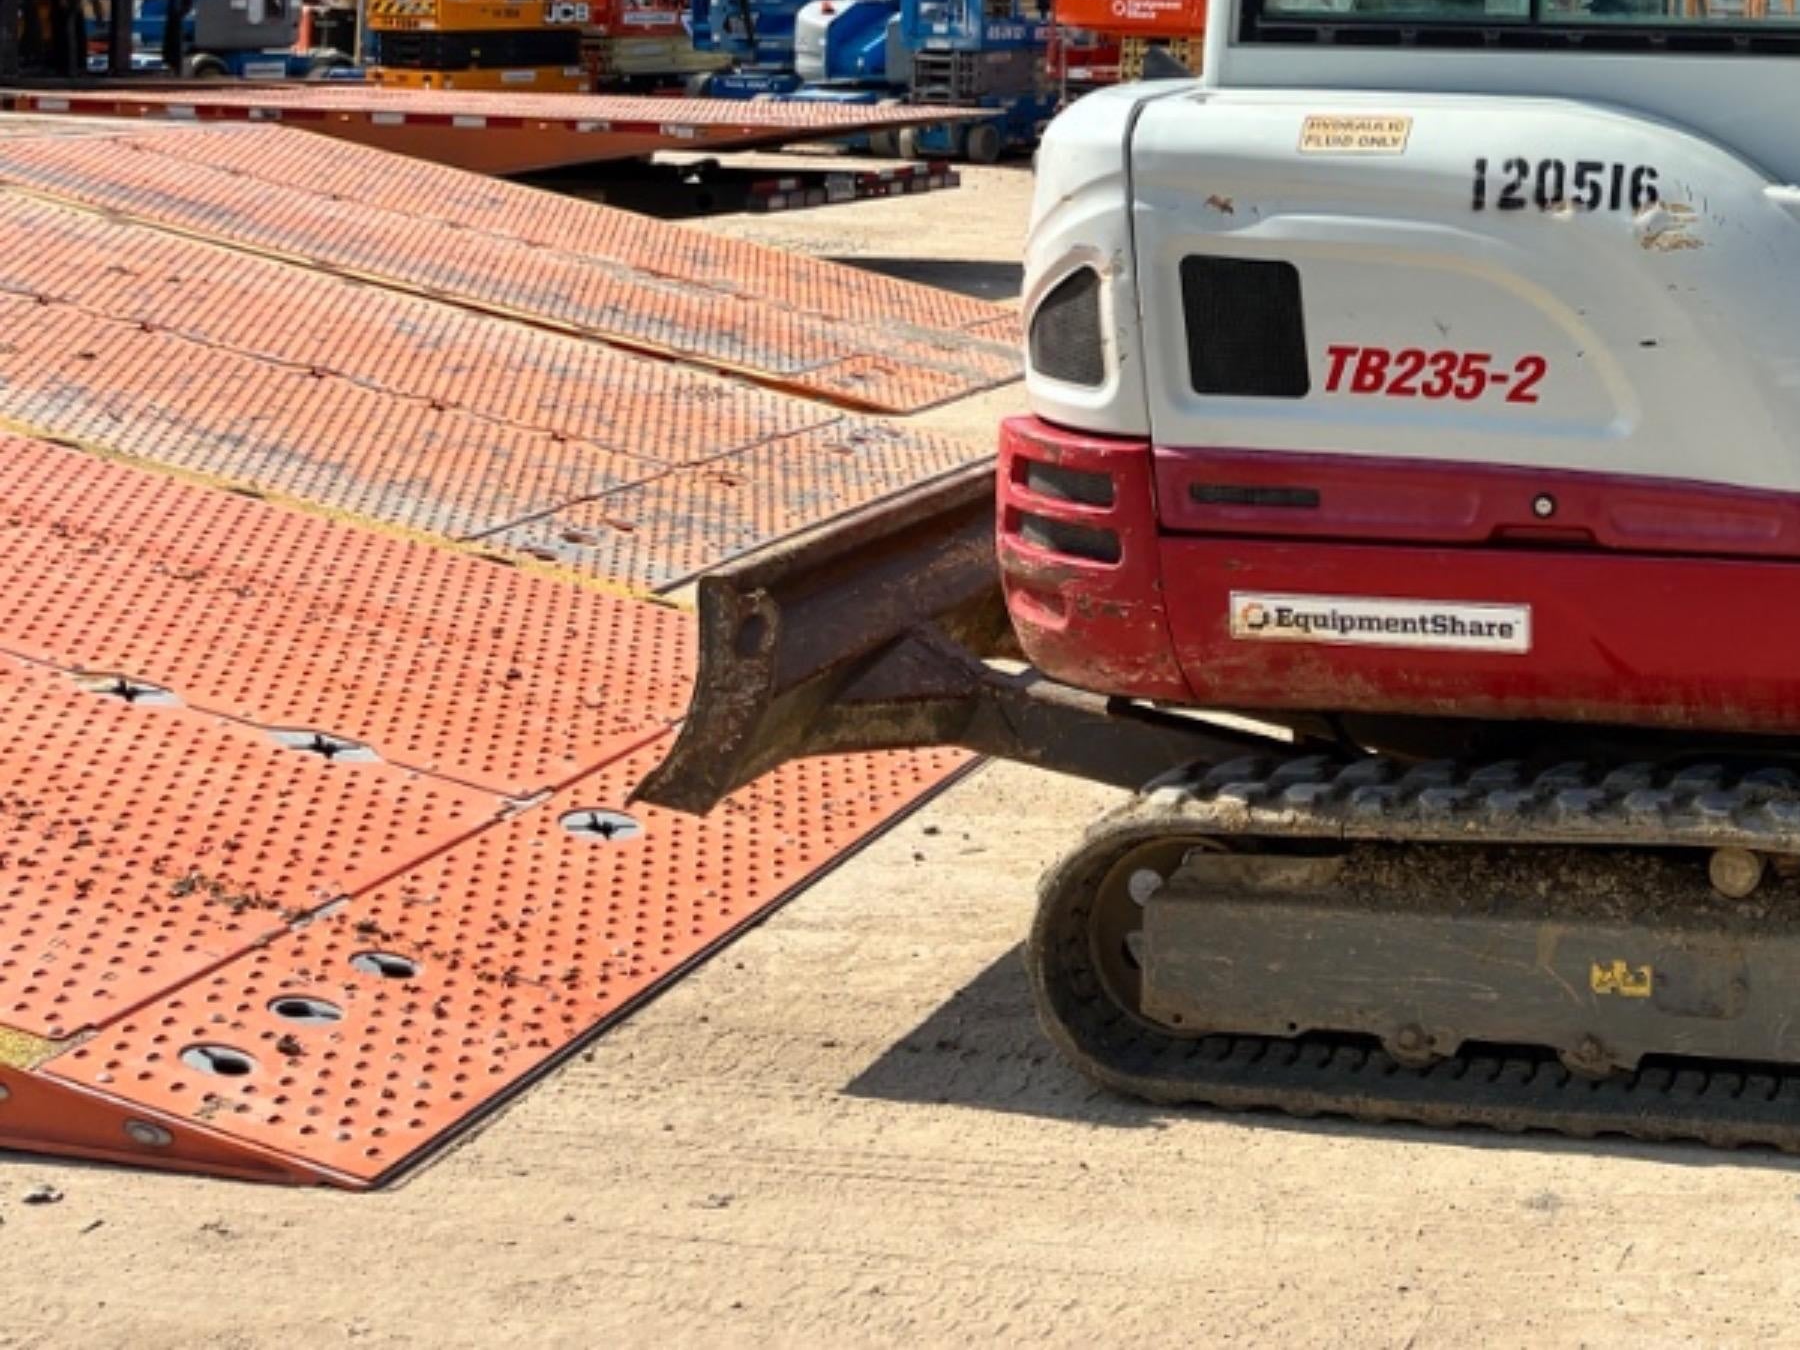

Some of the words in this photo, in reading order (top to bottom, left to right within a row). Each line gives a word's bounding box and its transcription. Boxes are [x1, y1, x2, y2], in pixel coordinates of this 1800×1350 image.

[545, 2, 589, 23] JCB
[1307, 119, 1405, 132] HYDRAULIC
[1304, 133, 1354, 147] FLUID
[1357, 134, 1402, 147] ONLY
[1471, 157, 1660, 212] 120516
[1325, 344, 1547, 404] TB235-2
[1274, 606, 1514, 639] EquipmentShare
